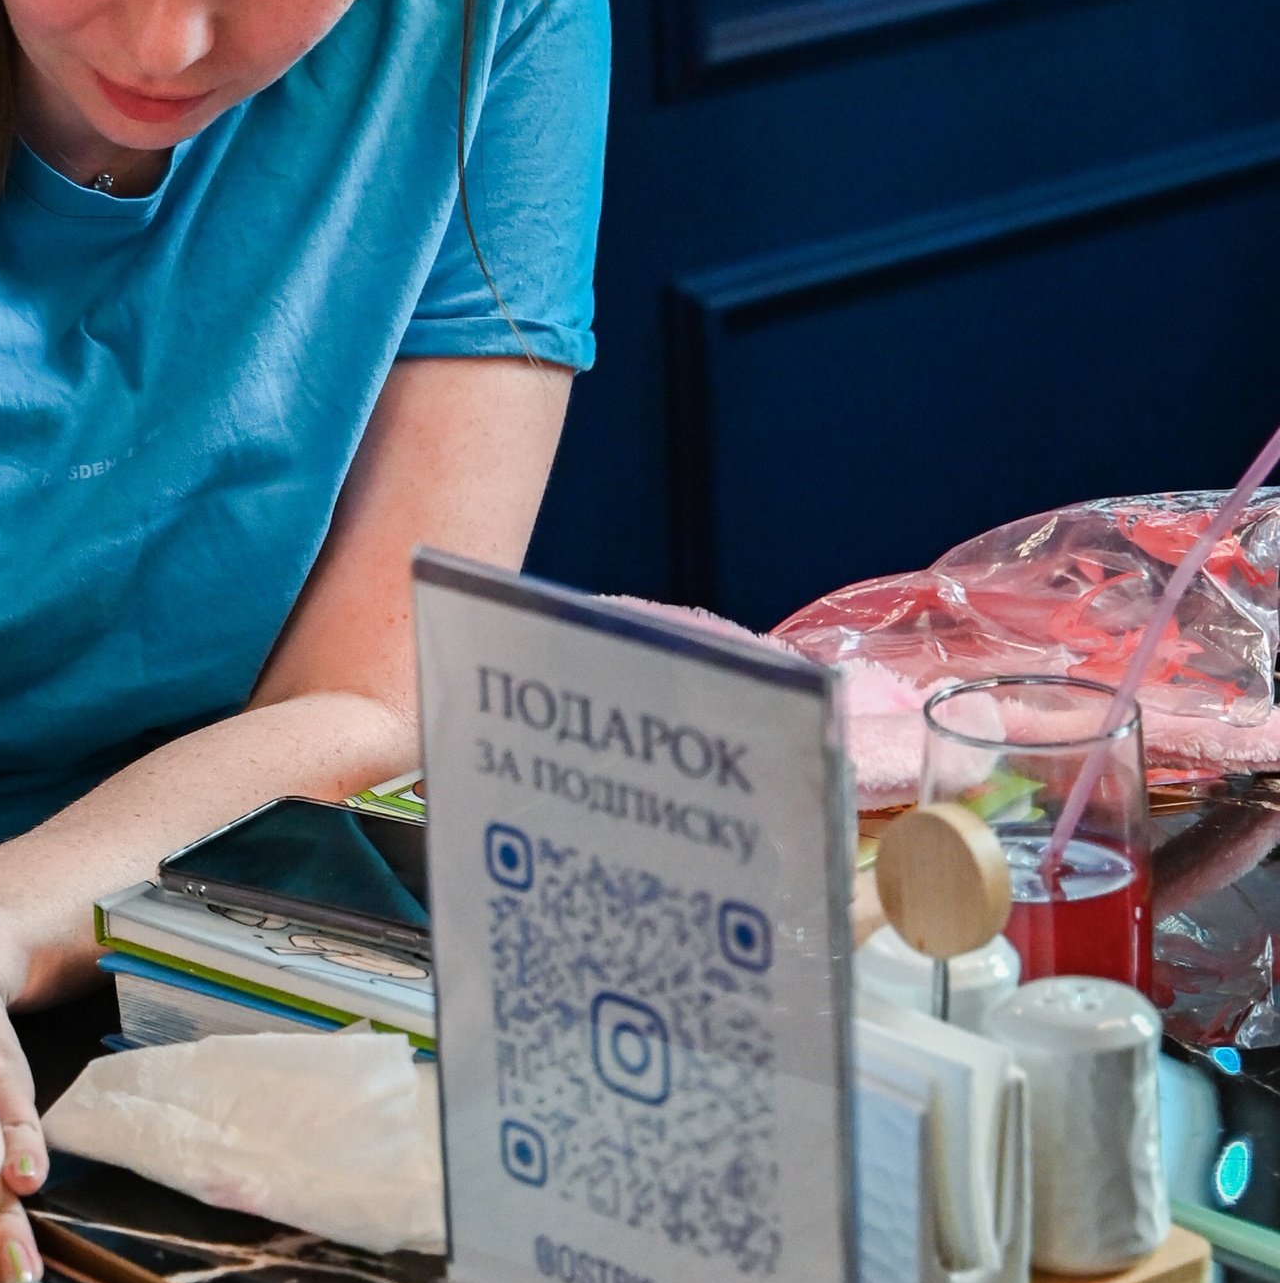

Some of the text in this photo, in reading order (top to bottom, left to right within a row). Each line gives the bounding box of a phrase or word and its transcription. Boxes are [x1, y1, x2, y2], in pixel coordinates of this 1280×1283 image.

[476, 665, 754, 795] ПОДАРОК
[476, 737, 760, 866] ЗА ПОДПИСКУ
